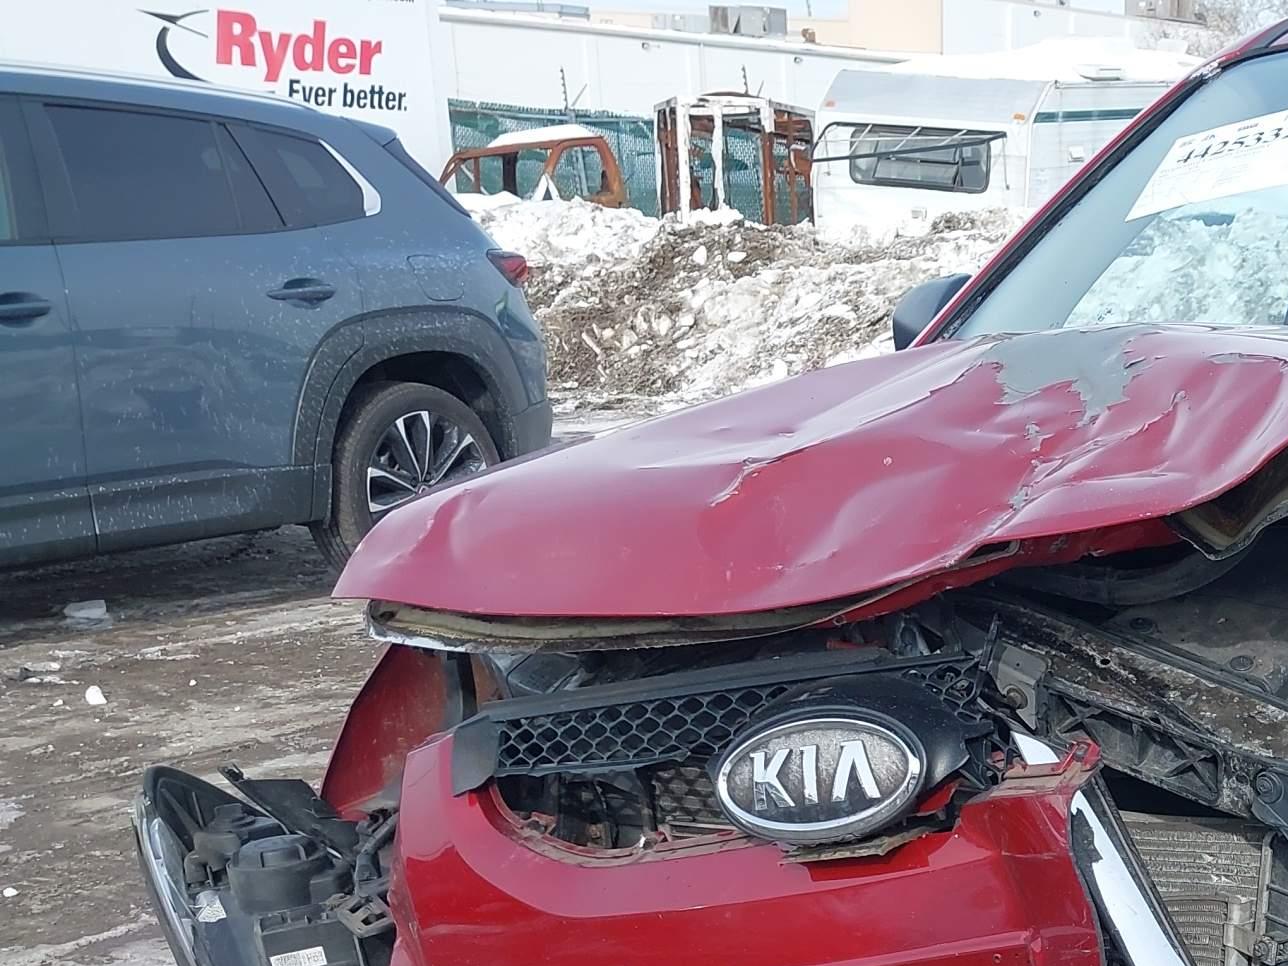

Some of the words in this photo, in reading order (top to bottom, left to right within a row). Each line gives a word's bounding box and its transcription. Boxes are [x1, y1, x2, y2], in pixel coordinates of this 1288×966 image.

[216, 9, 383, 83] Ryder
[288, 78, 337, 107] Ever
[342, 82, 408, 112] better.
[749, 739, 882, 811] KIA
